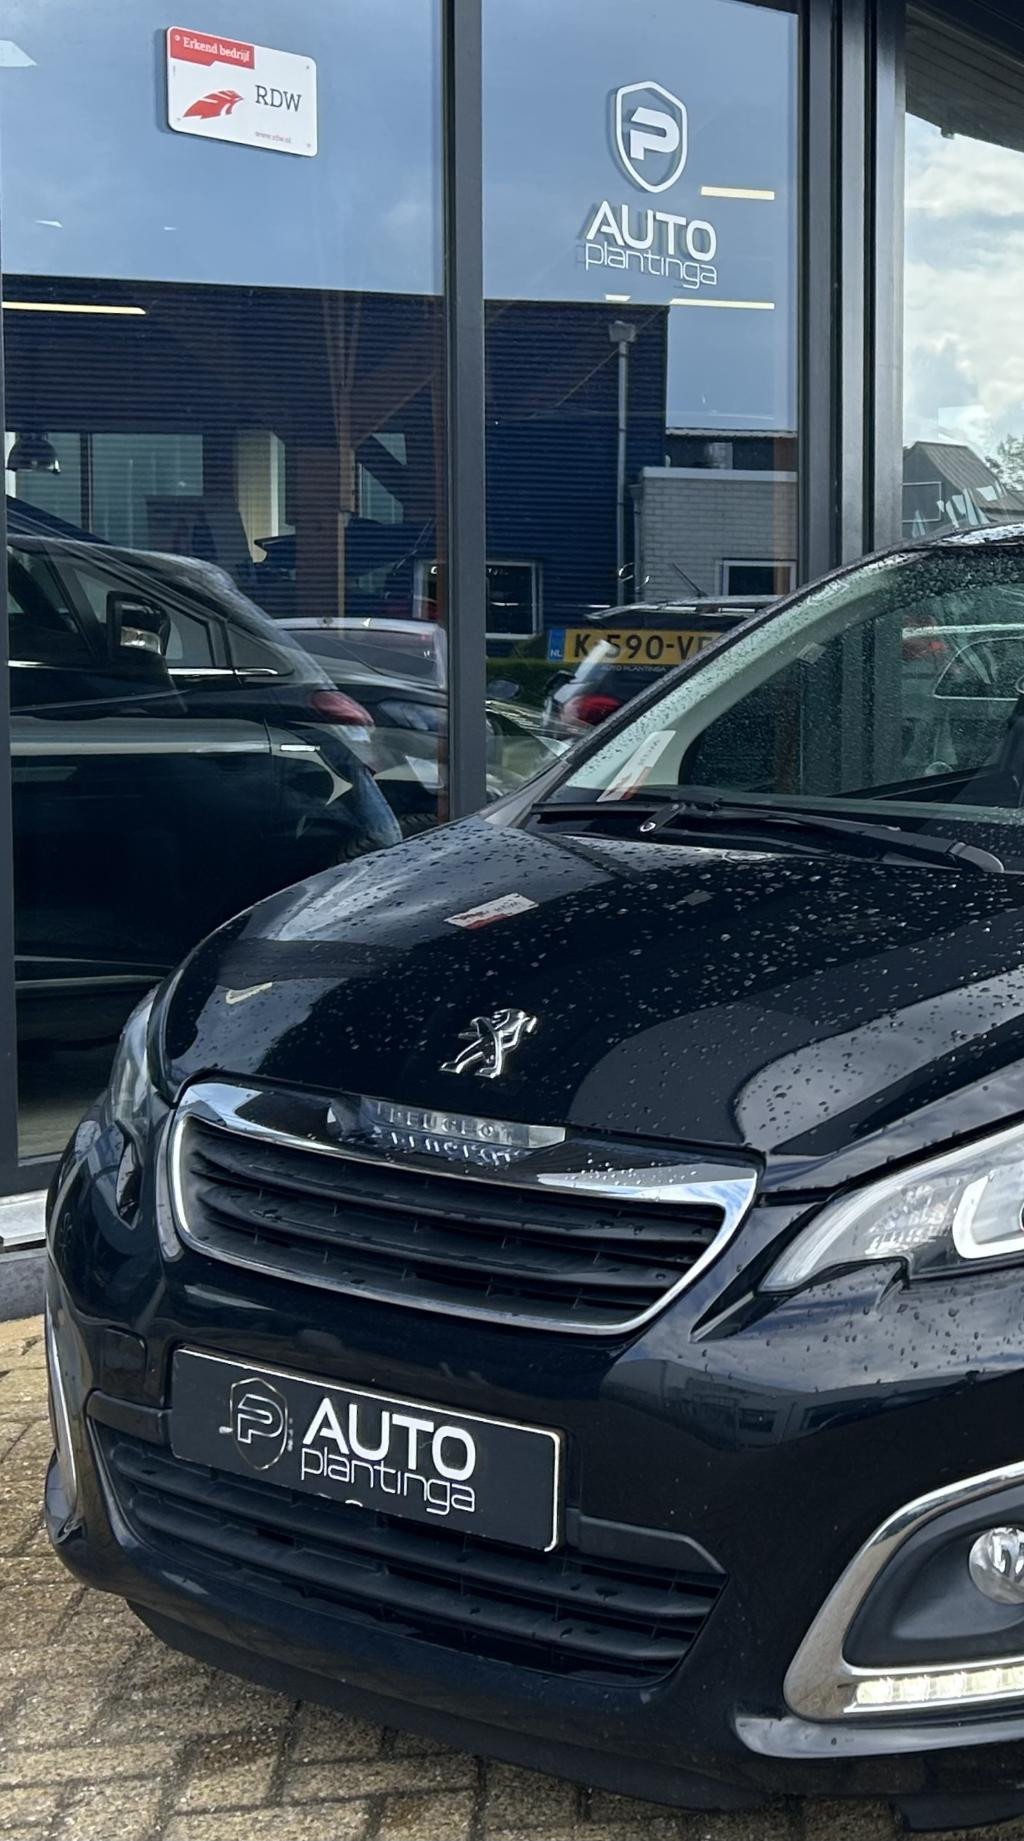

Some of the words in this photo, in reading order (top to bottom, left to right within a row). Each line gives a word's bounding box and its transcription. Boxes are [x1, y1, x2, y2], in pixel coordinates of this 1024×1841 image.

[183, 36, 218, 55] Erkend
[219, 44, 251, 63] bedrijf
[255, 84, 302, 112] RDW
[586, 200, 717, 262] AUTO
[585, 241, 718, 289] plantinga
[550, 648, 563, 658] NL
[302, 1398, 476, 1481] AUTO
[301, 1446, 476, 1515] plantinga
